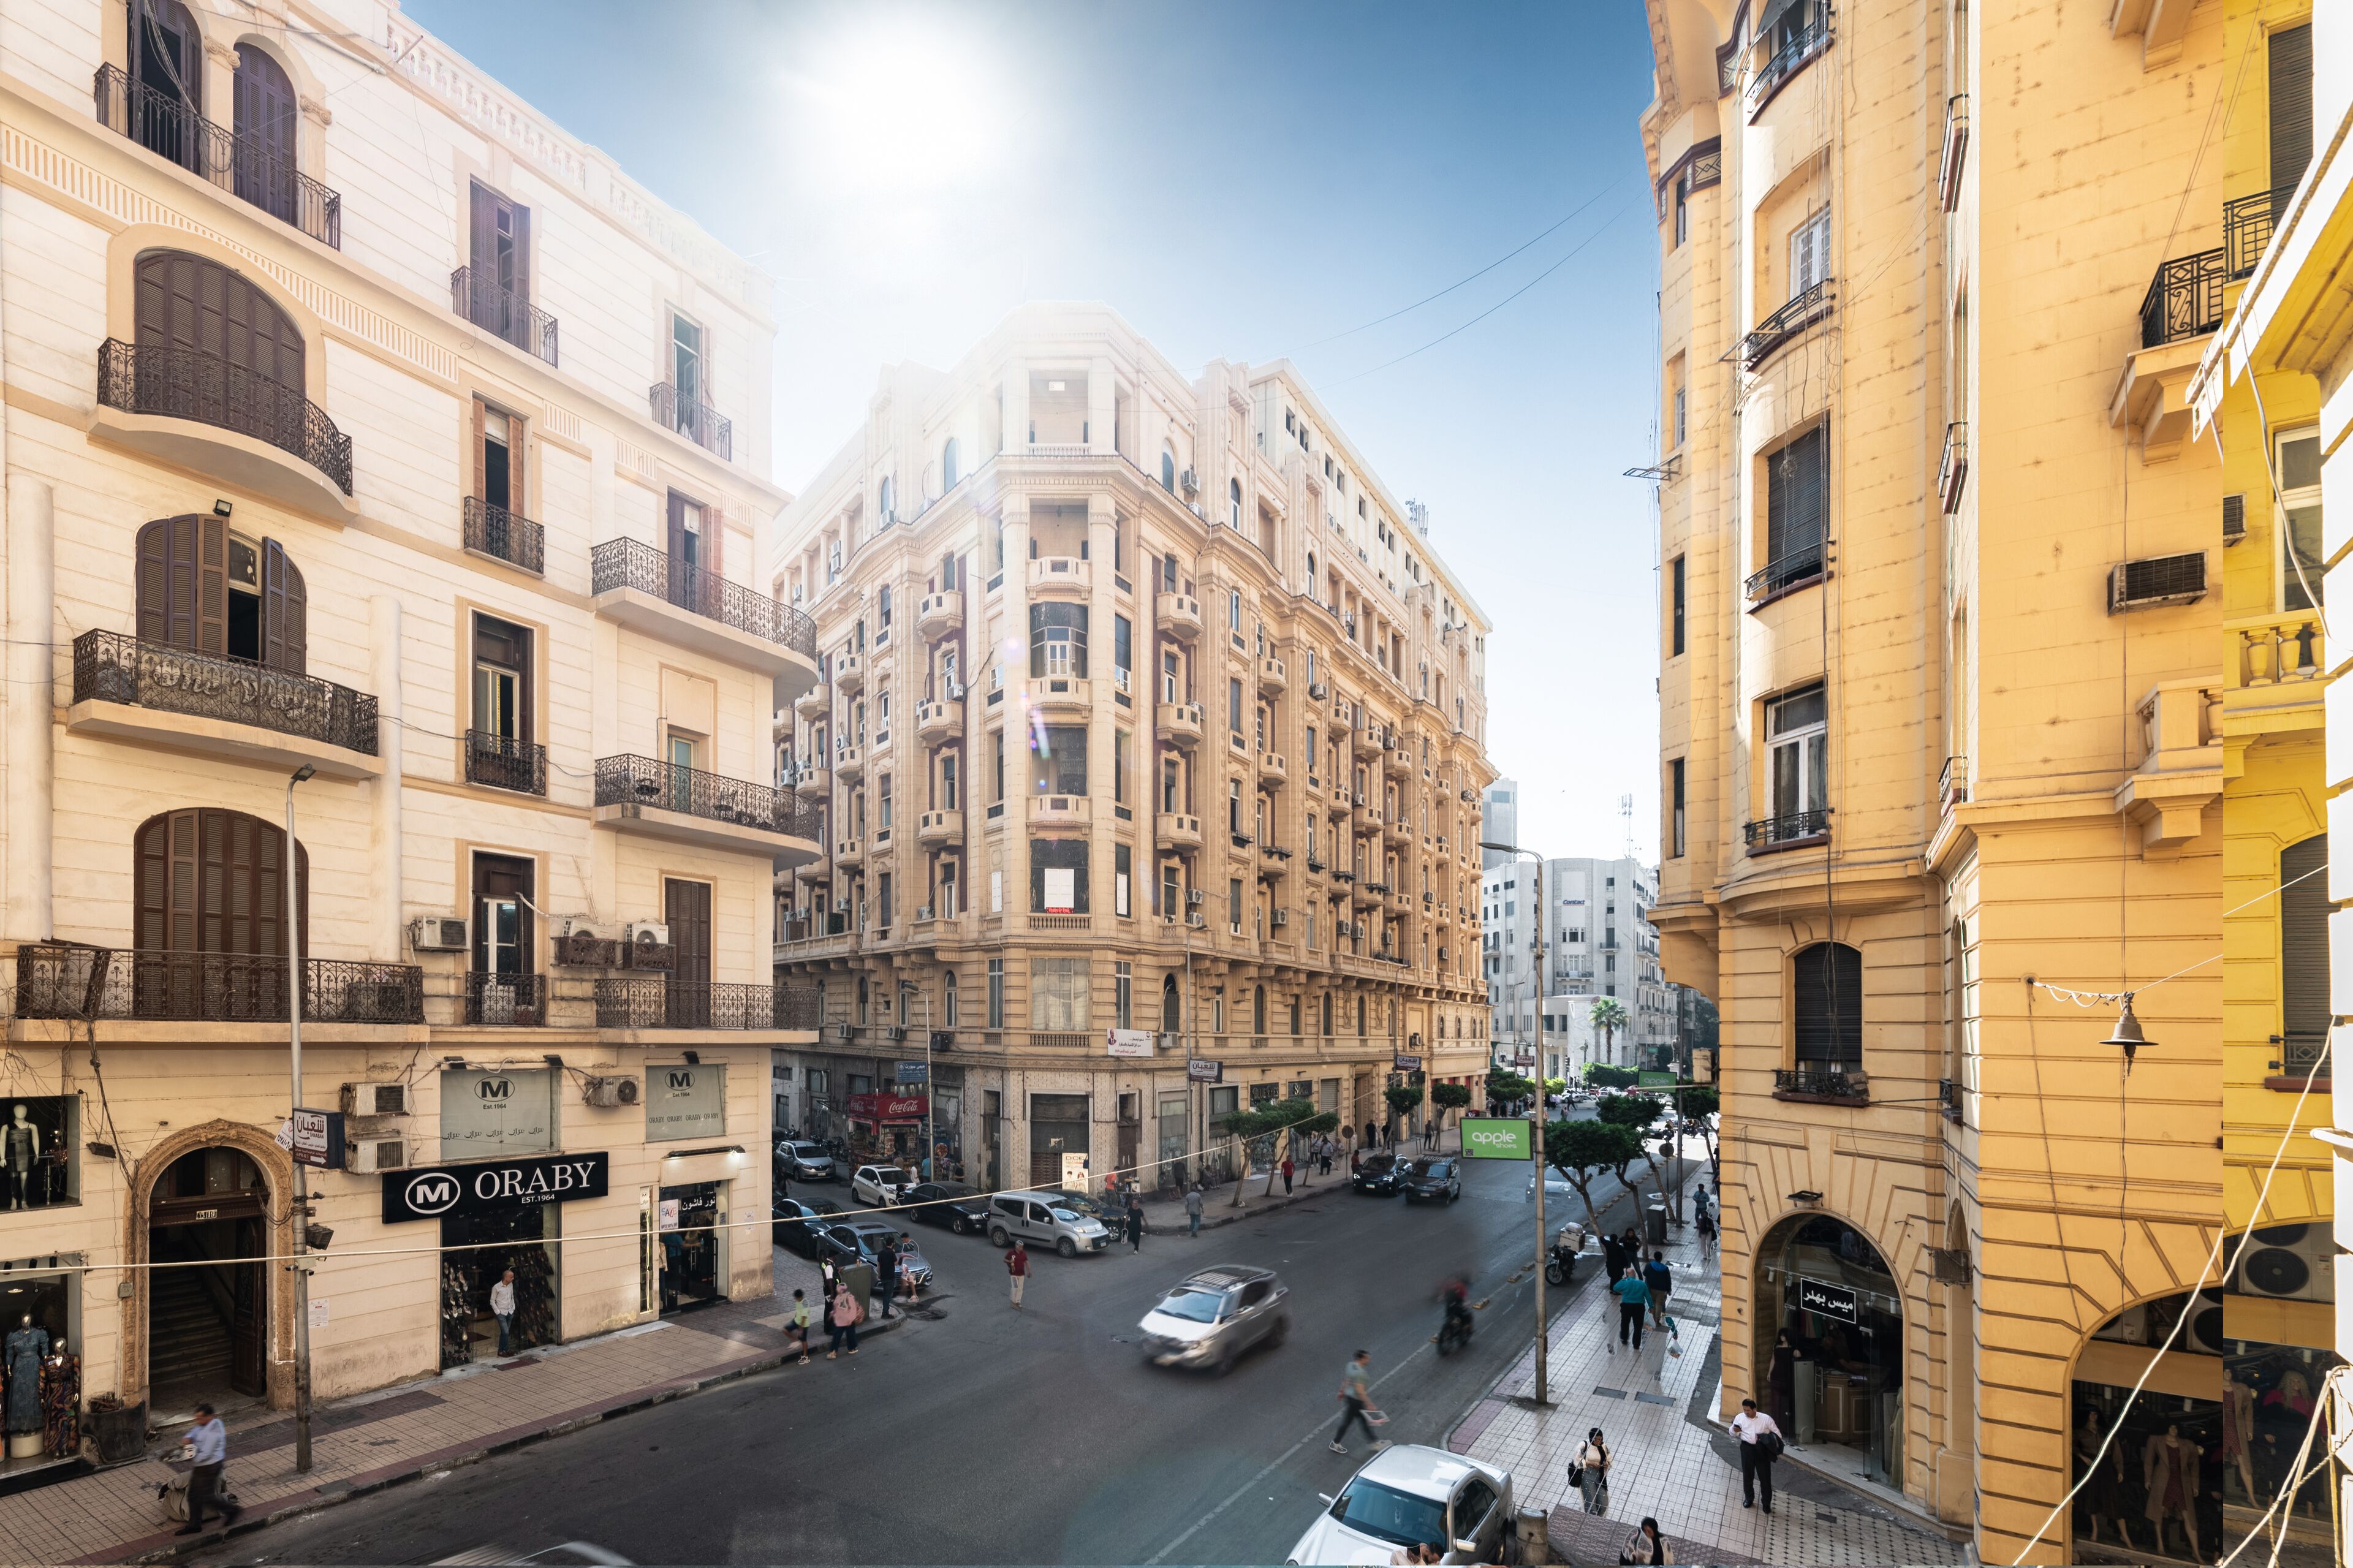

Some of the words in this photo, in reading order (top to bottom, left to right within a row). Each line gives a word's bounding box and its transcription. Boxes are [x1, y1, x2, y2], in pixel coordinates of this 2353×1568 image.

[1192, 1062, 1215, 1070] شعبان
[669, 1072, 691, 1088] M
[481, 1080, 509, 1099] M
[889, 1099, 919, 1114] Coca-Cola
[297, 1115, 324, 1135] شعبان
[1472, 1129, 1517, 1145] apple
[474, 1162, 596, 1199] ORABY
[416, 1182, 449, 1204] M
[521, 1194, 555, 1203] EST.1964
[681, 1197, 703, 1211] فاشون
[704, 1195, 716, 1207] نور
[1828, 1300, 1854, 1312] ميس
